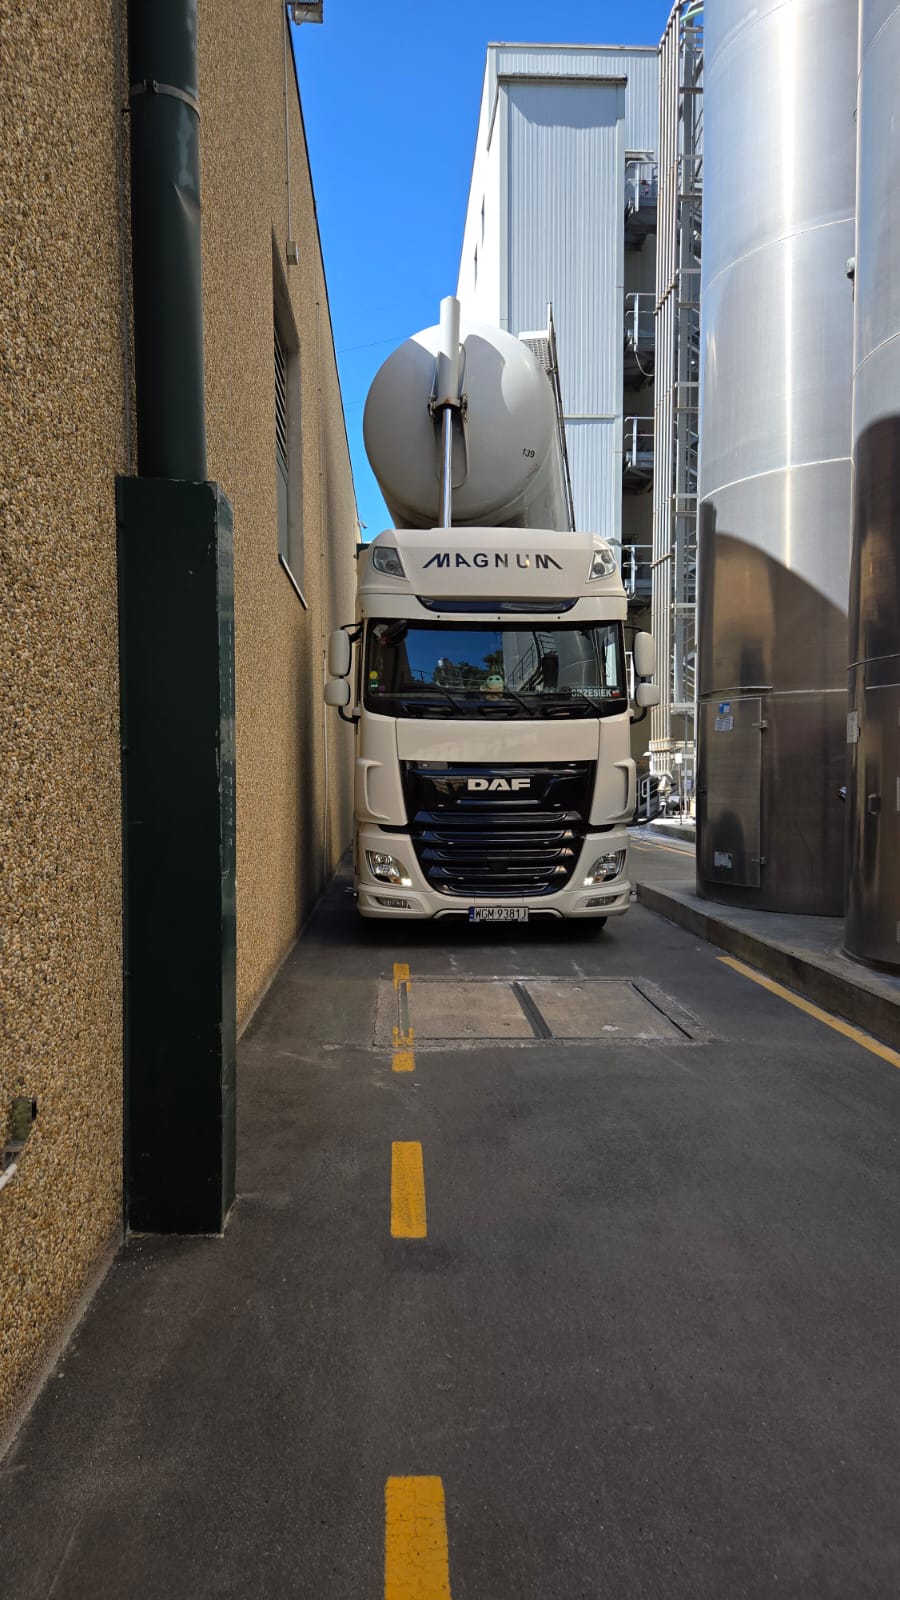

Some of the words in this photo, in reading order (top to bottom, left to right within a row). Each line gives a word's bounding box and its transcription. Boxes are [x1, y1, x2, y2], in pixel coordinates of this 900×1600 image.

[422, 553, 563, 569] MAGNUM
[467, 778, 531, 791] DAF
[475, 908, 494, 919] WGM
[497, 908, 527, 919] 9381J
